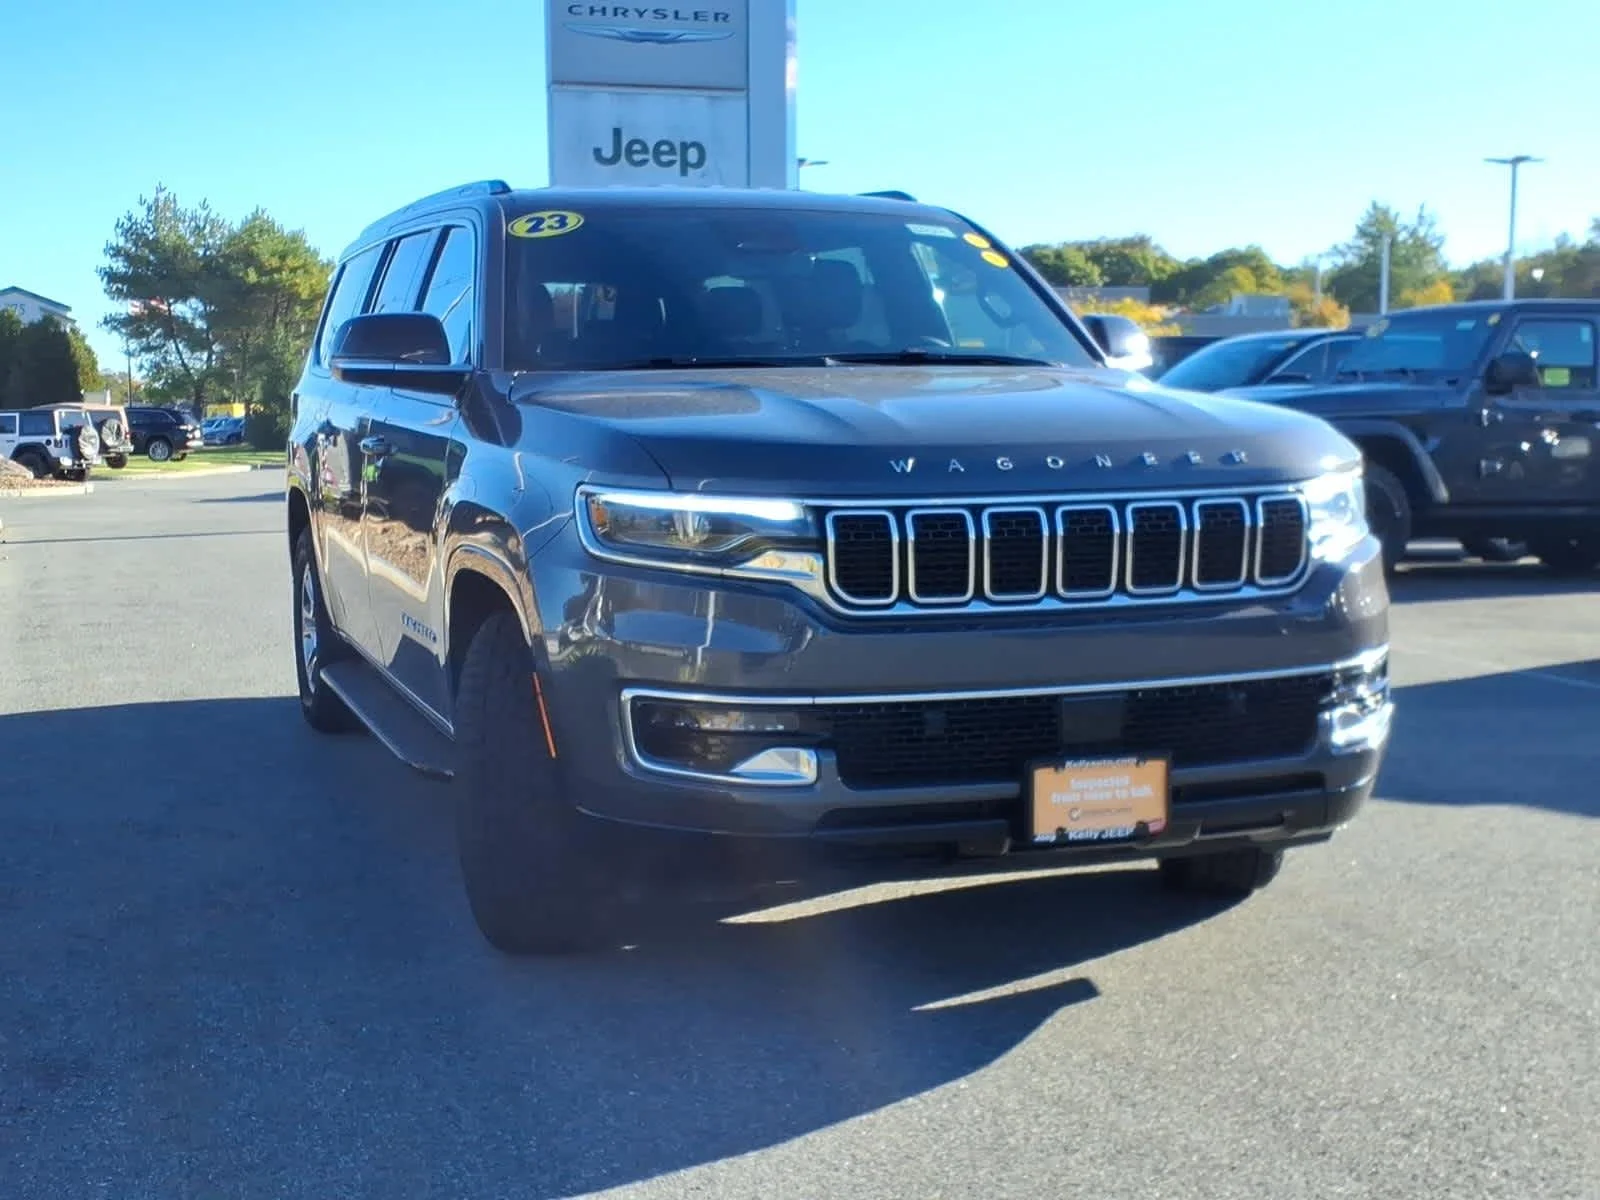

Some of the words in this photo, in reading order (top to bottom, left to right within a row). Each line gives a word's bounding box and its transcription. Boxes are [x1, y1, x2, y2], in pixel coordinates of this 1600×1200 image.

[567, 4, 731, 23] CHRYSLER
[592, 127, 707, 177] Jeep
[523, 213, 569, 234] 23
[889, 449, 1249, 474] WAGONEER
[1068, 828, 1100, 841] Kelly
